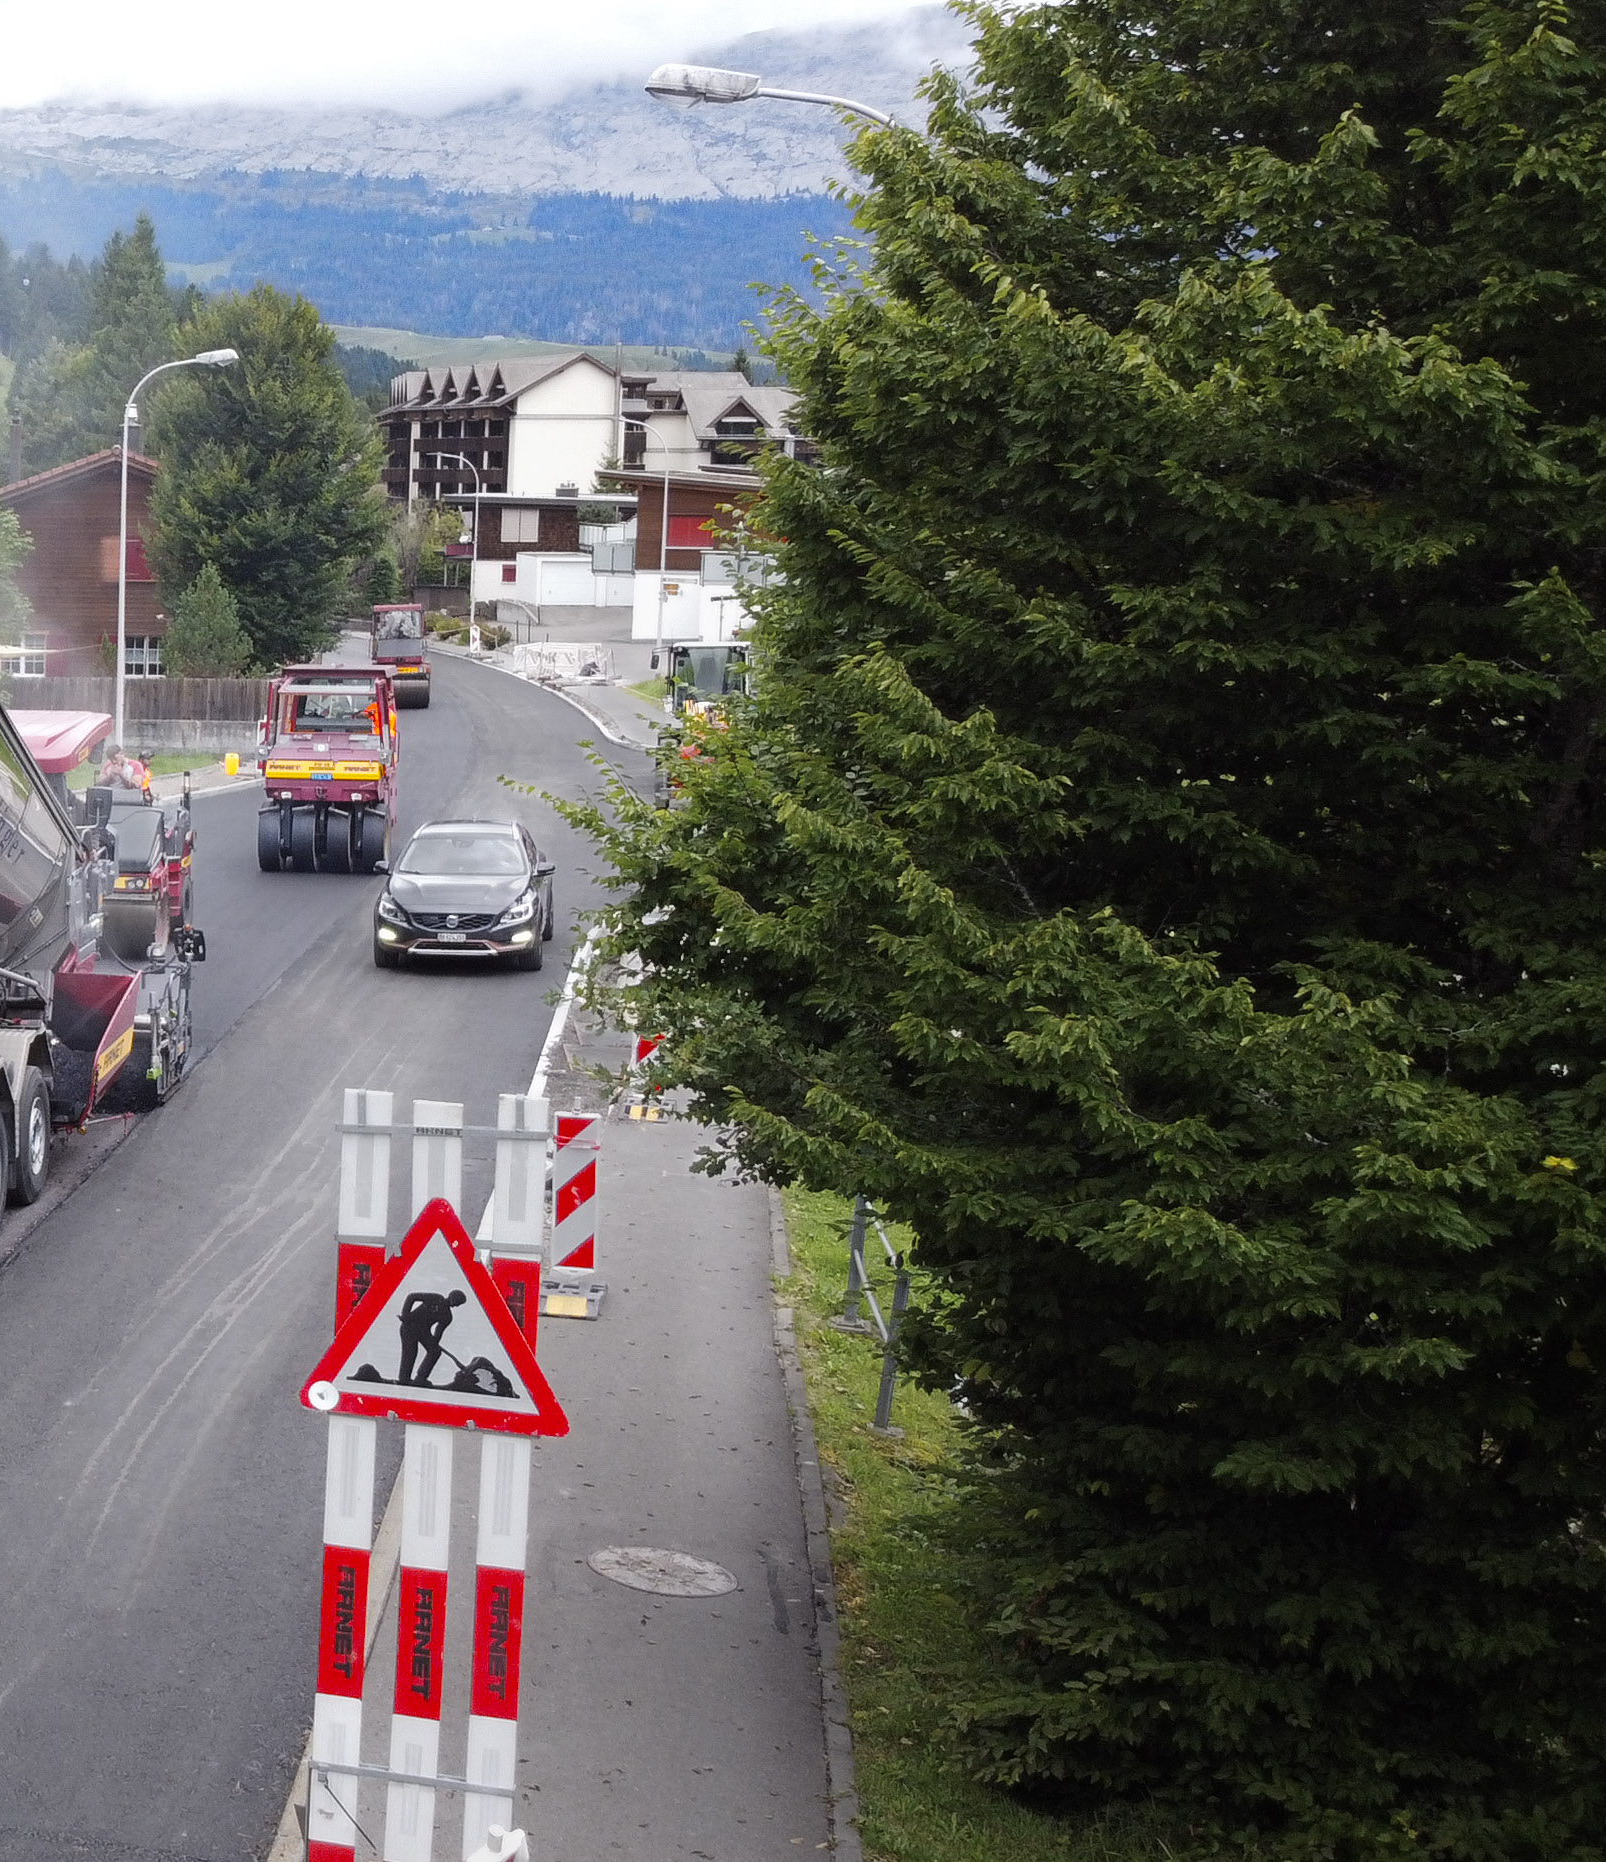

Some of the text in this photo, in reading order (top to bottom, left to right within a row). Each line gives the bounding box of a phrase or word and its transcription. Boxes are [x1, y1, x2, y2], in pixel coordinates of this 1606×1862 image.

[333, 1566, 356, 1679] ARNET
[411, 1587, 433, 1701] ARNET
[488, 1585, 510, 1701] ARNET
